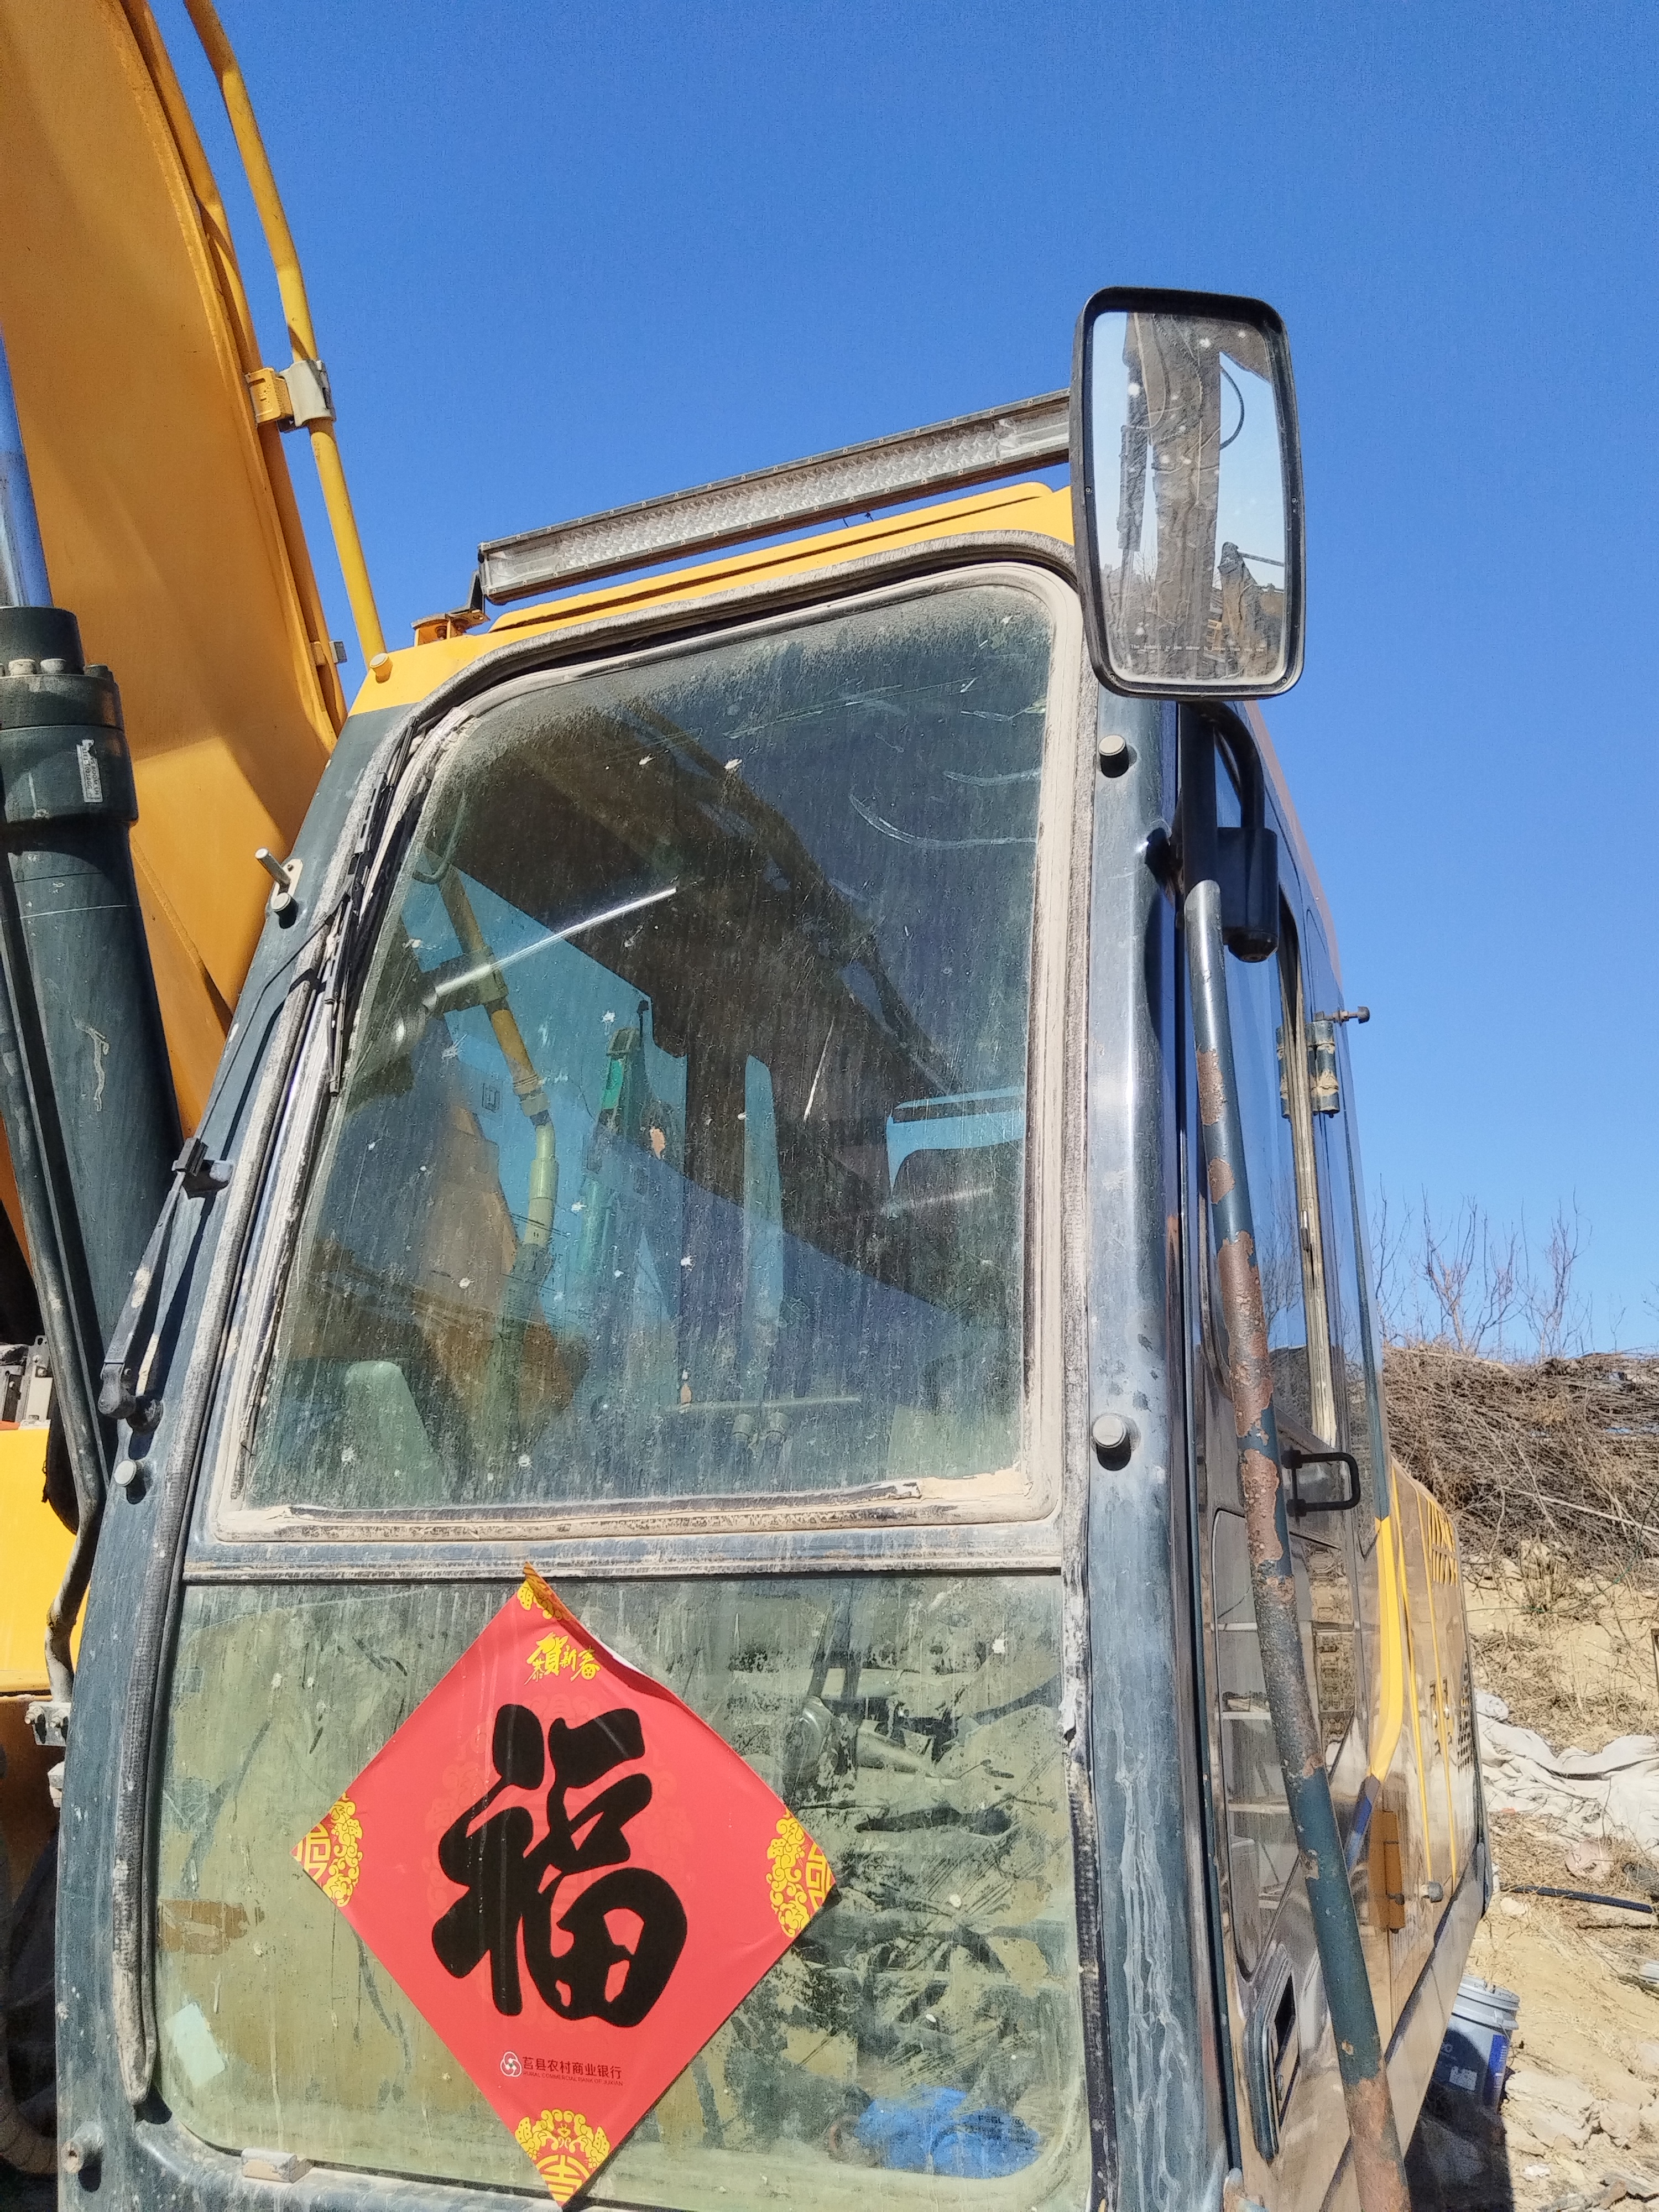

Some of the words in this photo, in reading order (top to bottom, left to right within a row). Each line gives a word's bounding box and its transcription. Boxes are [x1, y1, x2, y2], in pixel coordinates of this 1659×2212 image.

[431, 1704, 687, 2027] 福
[523, 2057, 622, 2079] 莒县农村商业银行
